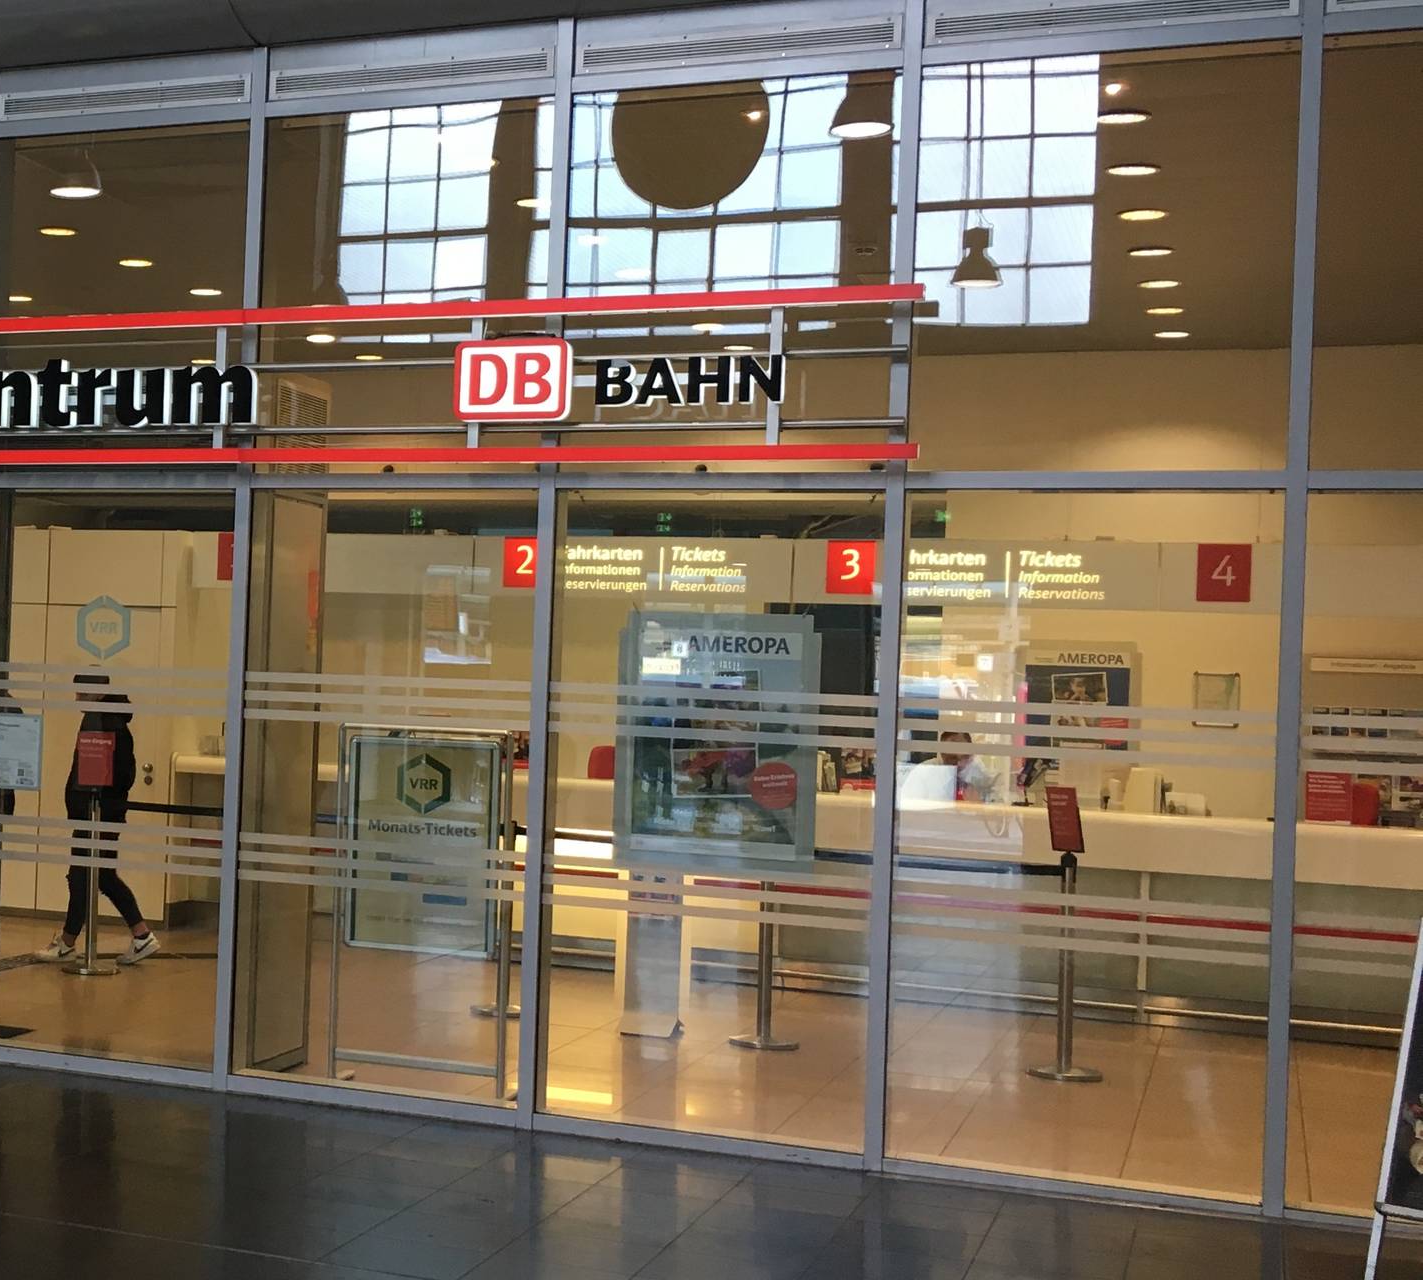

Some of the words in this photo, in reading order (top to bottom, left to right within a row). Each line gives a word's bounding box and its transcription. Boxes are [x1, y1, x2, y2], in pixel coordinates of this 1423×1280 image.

[468, 353, 552, 405] DB
[595, 354, 784, 406] BAHN
[515, 545, 534, 575] 2
[565, 545, 644, 561] ahrkarten
[671, 546, 726, 562] Tickets
[841, 549, 861, 580] 3
[909, 549, 987, 567] hrkarten
[1019, 550, 1083, 568] Tickets
[565, 563, 641, 576] nformationen
[670, 565, 742, 579] Information
[907, 569, 984, 582] ormationen
[1018, 571, 1100, 586] Information
[1211, 556, 1237, 586] 4
[565, 579, 647, 593] eservierungen
[670, 581, 746, 593] Reservations
[907, 586, 992, 601] servierungen
[1018, 587, 1106, 601] Reservations
[90, 621, 118, 635] VRR
[687, 635, 791, 656] AMEROPA
[1057, 653, 1125, 666] AMEROPA
[409, 777, 439, 791] VRR
[368, 819, 478, 838] Monats-Tickets
